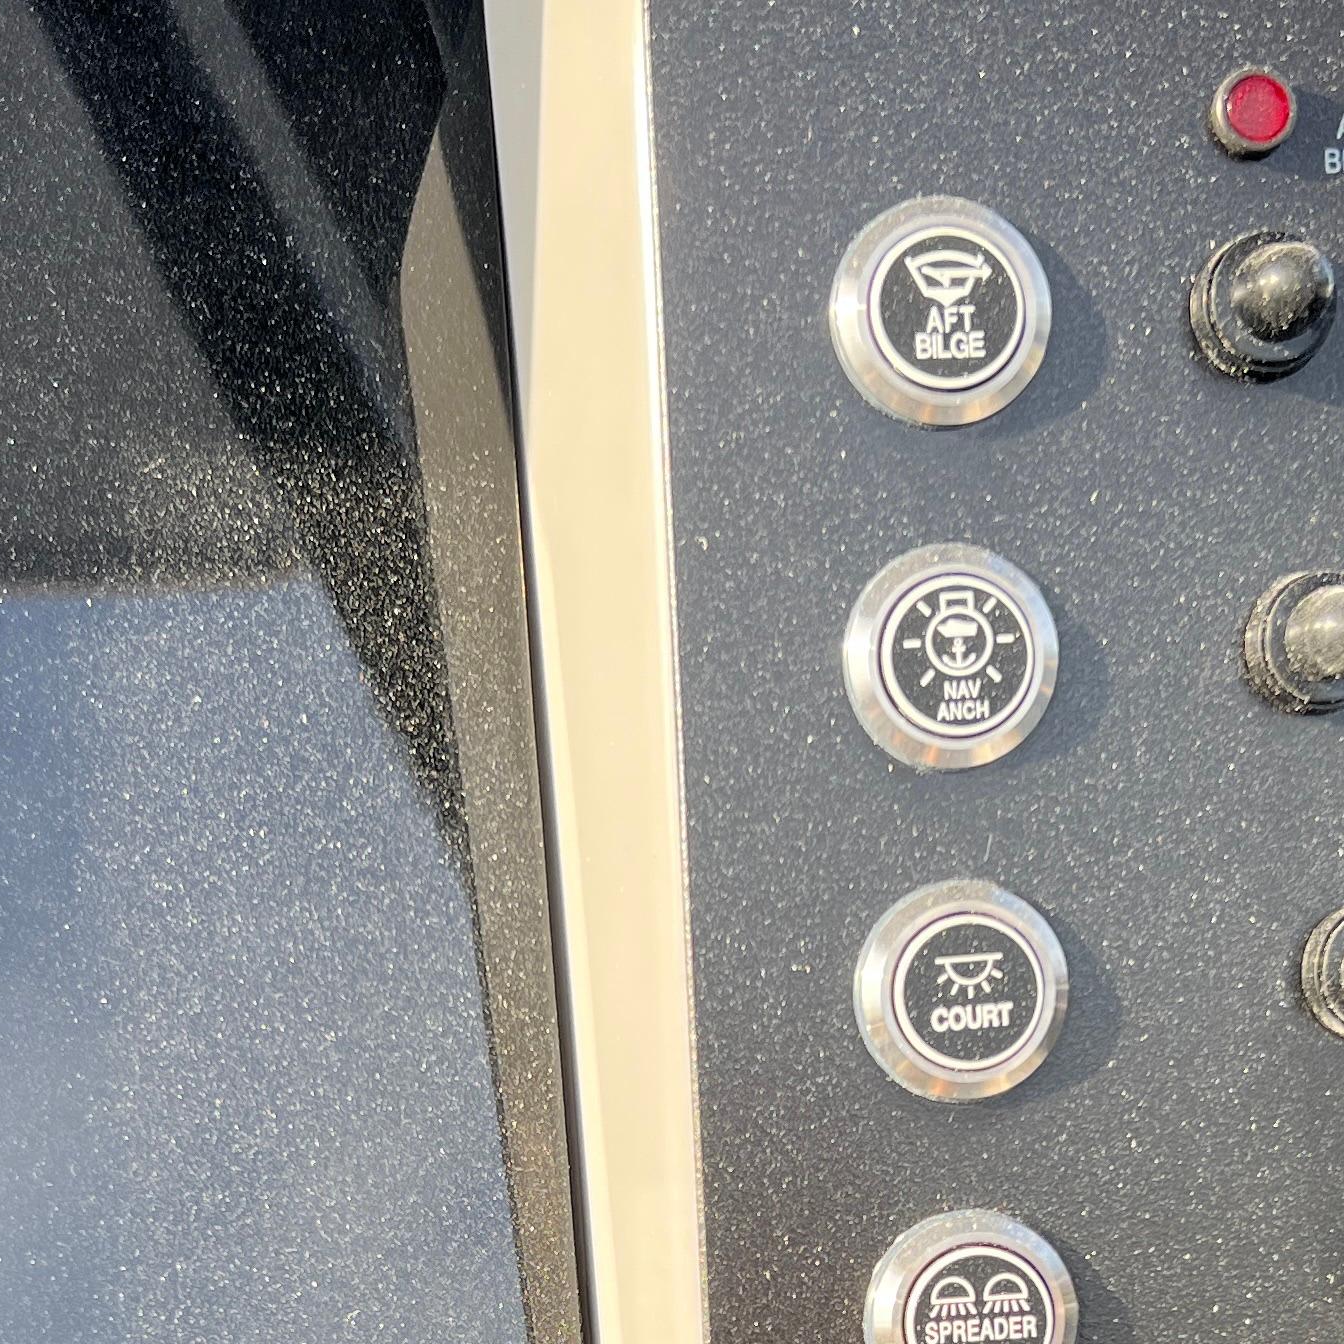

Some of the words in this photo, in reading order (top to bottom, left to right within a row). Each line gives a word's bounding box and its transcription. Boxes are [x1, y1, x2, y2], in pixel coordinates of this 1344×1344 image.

[926, 304, 976, 334] AFT
[915, 330, 987, 360] BILGE
[943, 678, 982, 700] NAV
[937, 696, 990, 721] ANCH
[930, 1000, 1014, 1033] COURT
[924, 1315, 1038, 1344] SPREADER
